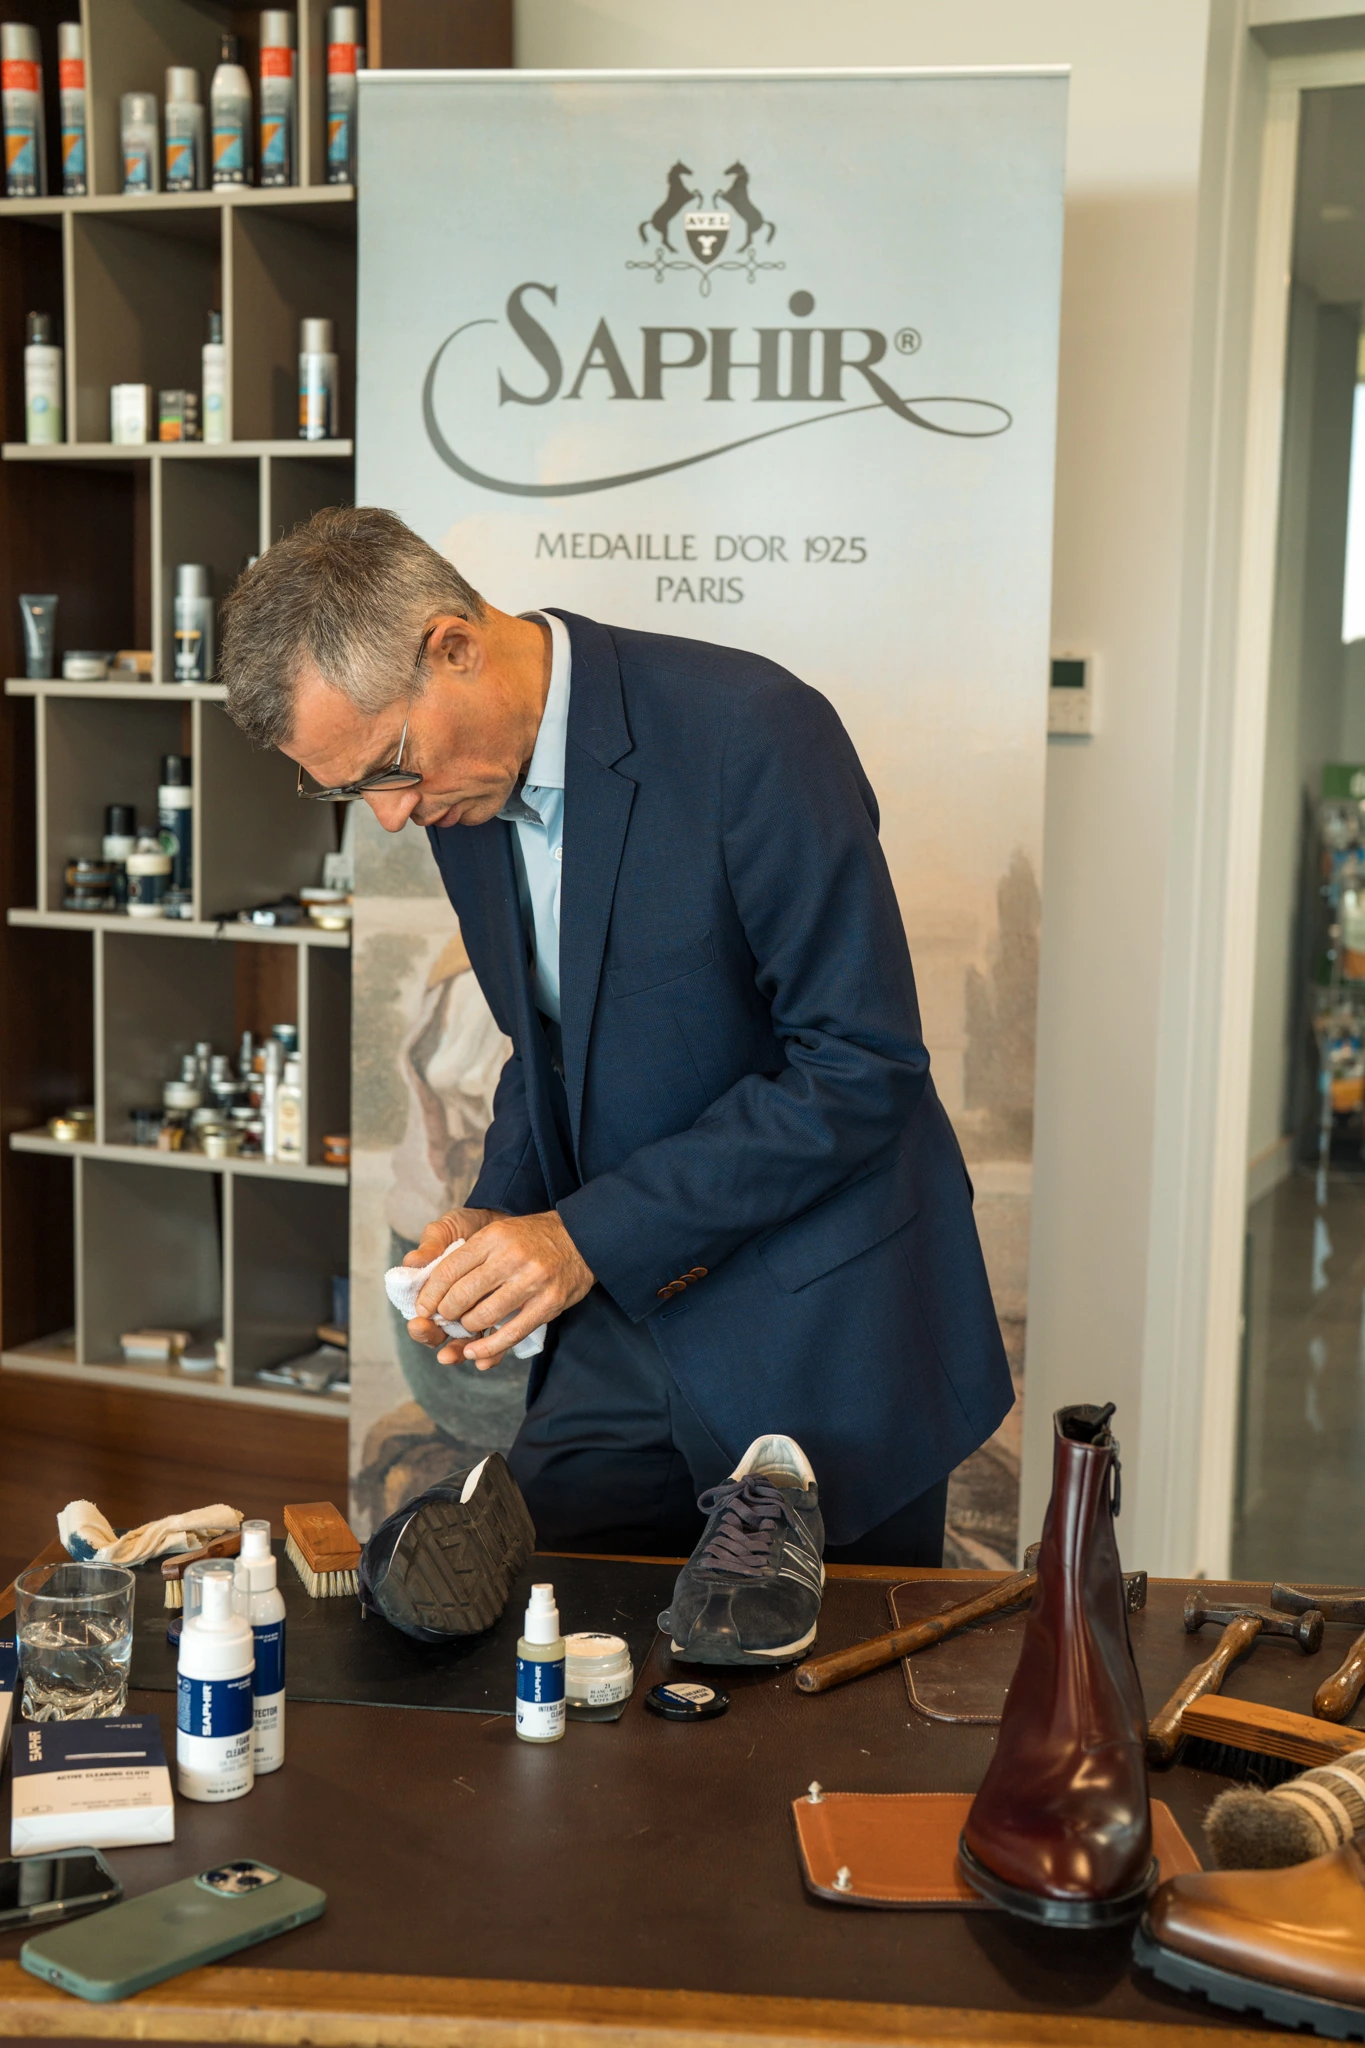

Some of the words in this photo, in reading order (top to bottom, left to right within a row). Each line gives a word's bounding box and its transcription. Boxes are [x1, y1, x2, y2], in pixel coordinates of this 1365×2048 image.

[687, 215, 730, 226] AVEL
[534, 532, 698, 561] MEDAILLE
[714, 534, 789, 563] D'OR
[803, 535, 868, 564] 1925
[655, 575, 745, 604] PARIS
[534, 1665, 542, 1702] SAPHIR
[202, 1684, 212, 1736] SAPHIR
[254, 1706, 277, 1718] TECTOR
[538, 1704, 557, 1712] INTENSE
[28, 1730, 42, 1762] SAPHIR
